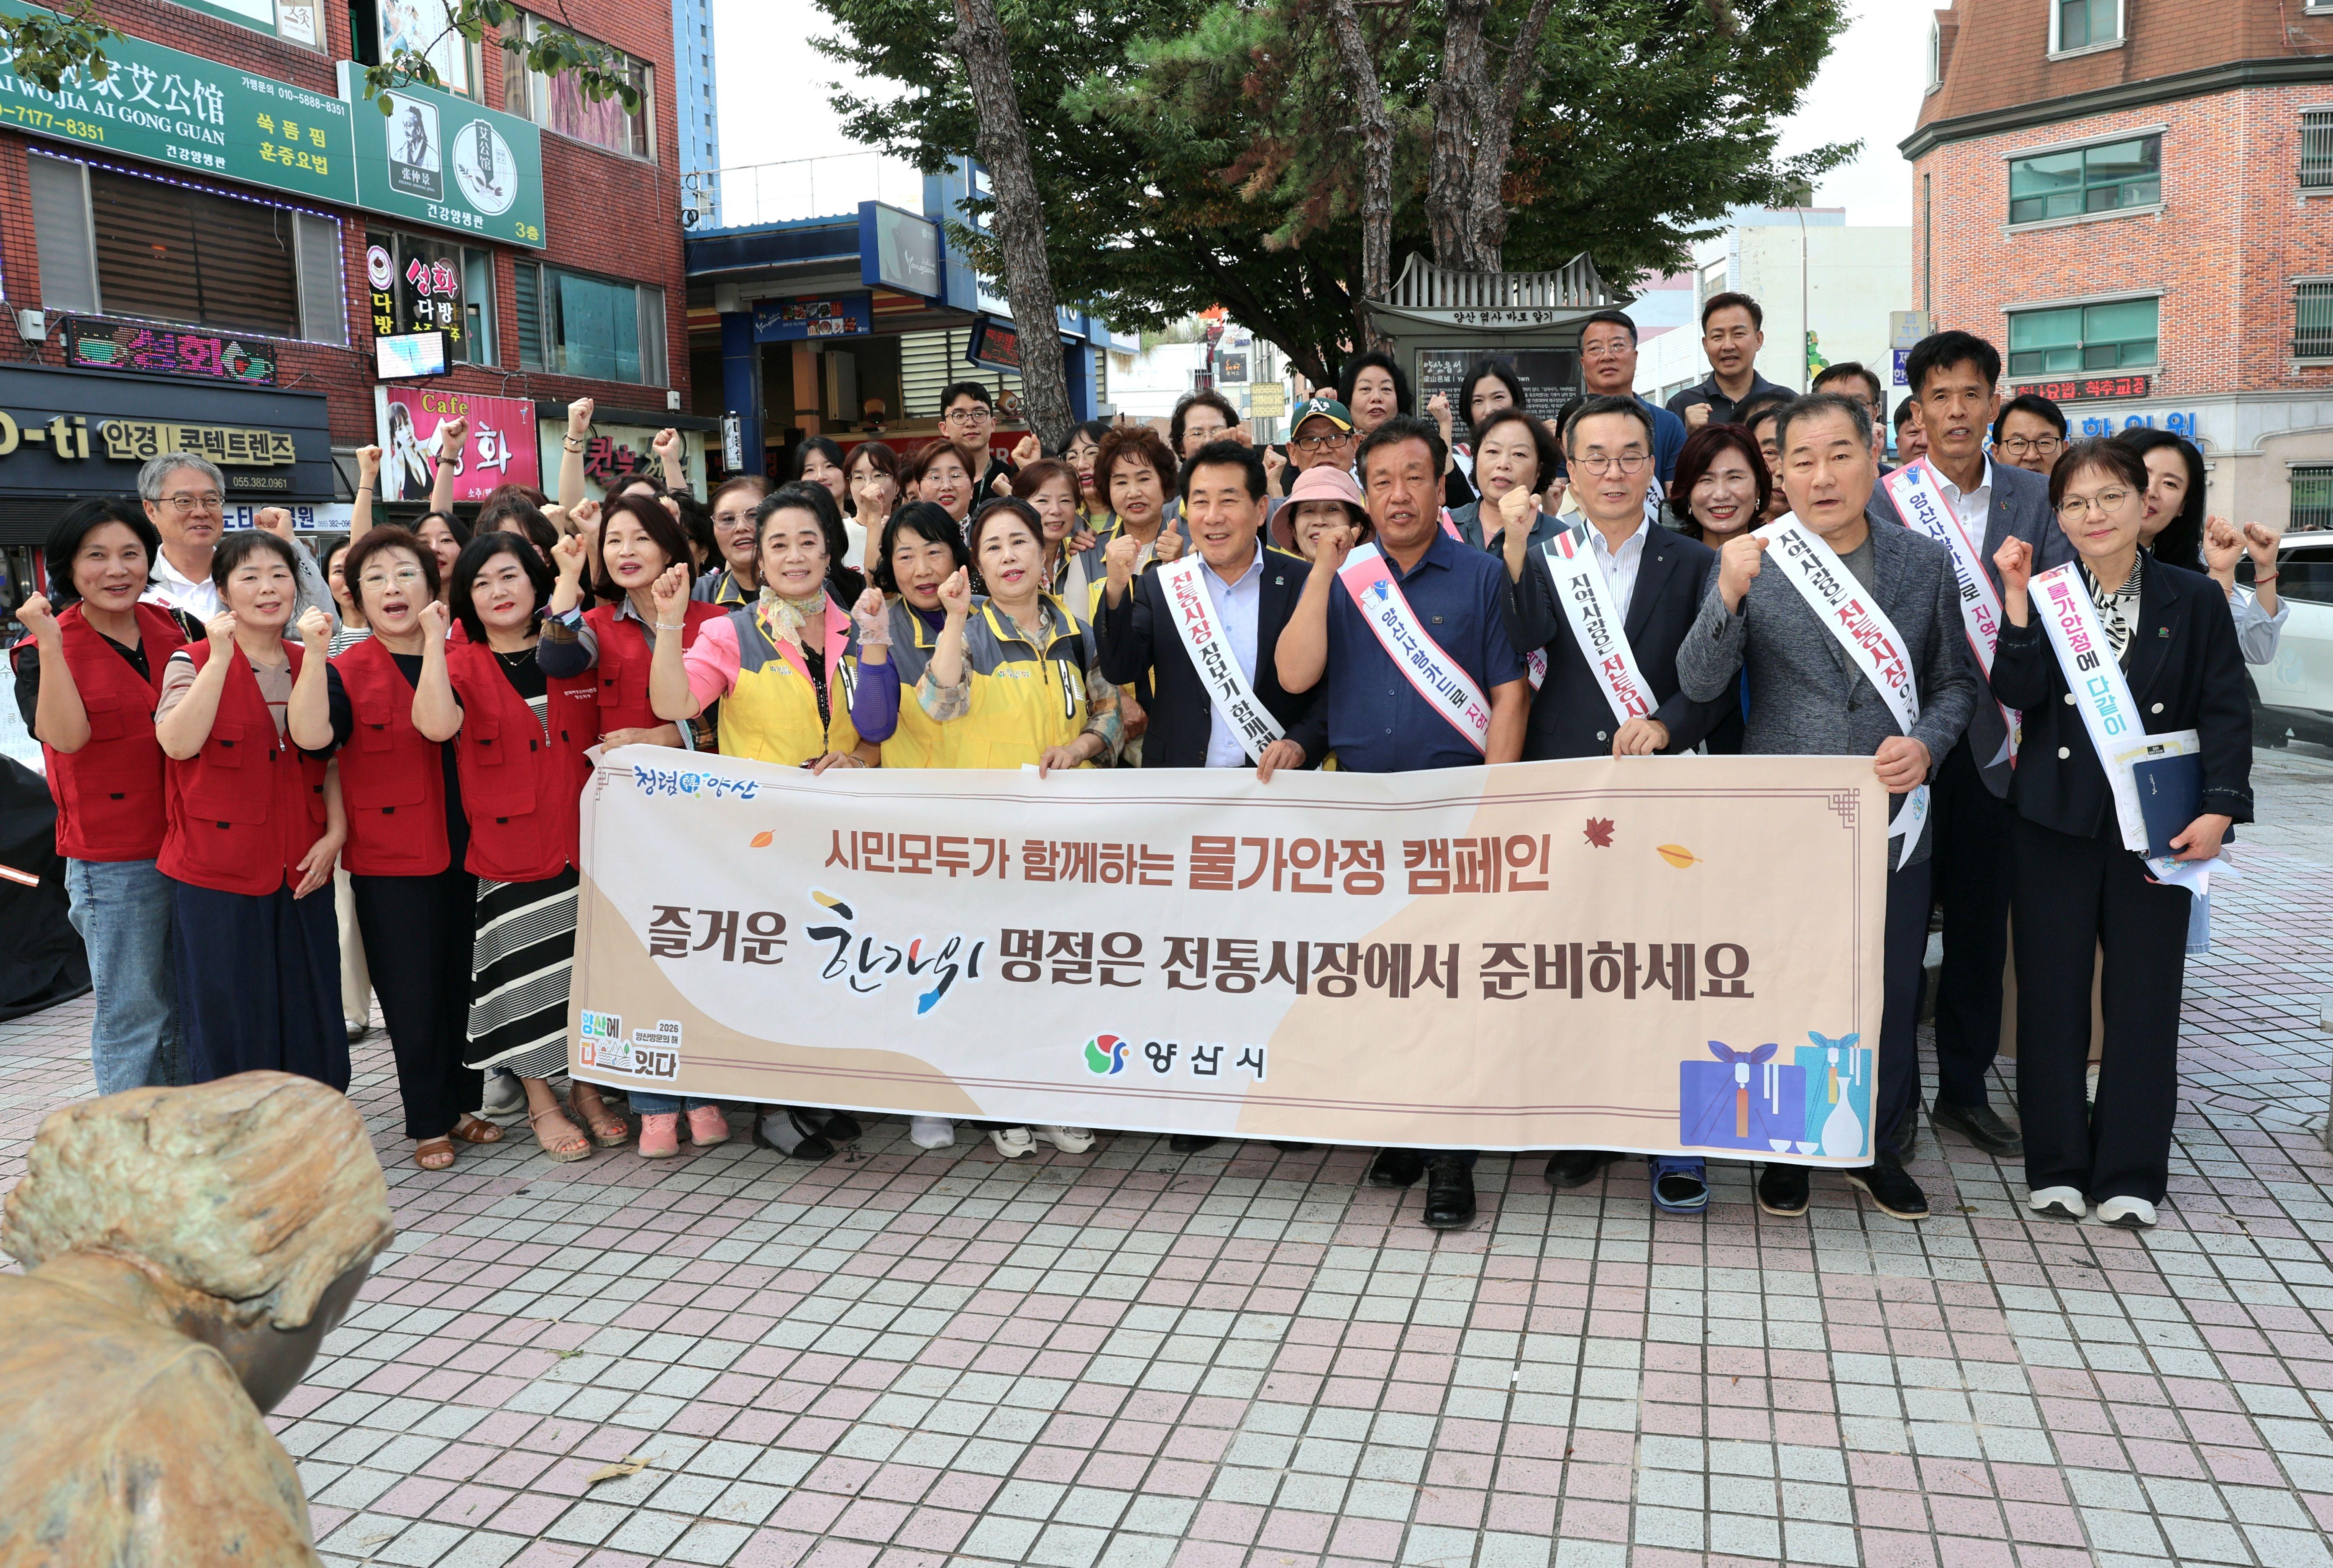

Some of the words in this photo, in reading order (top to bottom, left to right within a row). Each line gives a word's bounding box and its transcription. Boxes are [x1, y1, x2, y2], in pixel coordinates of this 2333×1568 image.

[242, 77, 274, 95] 가맹문의
[279, 87, 345, 116] 010-5888-8351
[0, 103, 104, 141] -7177-8351
[54, 90, 90, 113] JIA
[93, 100, 115, 119] AI
[119, 107, 171, 133] GONG
[176, 122, 225, 146] GUAN
[166, 143, 226, 170] 건강양생관
[259, 142, 328, 175] 훈증요법
[479, 126, 491, 171] 艾公馆
[402, 167, 430, 186] 张仲景
[427, 203, 484, 230] 건강양생관
[515, 222, 539, 241] 3층
[406, 258, 458, 298] 성화
[904, 250, 936, 275] Yangsan
[372, 293, 394, 335] 다방
[417, 298, 454, 324] 다방
[1454, 311, 1475, 323] 양산
[1480, 312, 1502, 324] 역사
[1506, 313, 1528, 323] 바로
[1532, 310, 1553, 323] 알기
[1423, 360, 1462, 374] 양산읍성
[422, 394, 469, 415] Cafe
[1306, 398, 1330, 416] A's
[106, 424, 159, 456] 안경
[233, 476, 287, 489] 055.382.0961
[1775, 528, 1848, 607] 지역사랑은
[1169, 570, 1212, 645] 전통시장
[1199, 641, 1241, 702] 장보기
[1568, 573, 1614, 656] 지역사랑은
[1599, 653, 1651, 720] 전통시
[1381, 607, 1468, 709] 양산사랑카드로
[2046, 581, 2100, 672] 물가안정에
[2086, 675, 2127, 736] 다같이
[707, 777, 759, 799] 양산
[824, 829, 1010, 879] 시민모두가
[1022, 839, 1174, 886] 함께하는
[1189, 835, 1385, 896] 물가안정
[1403, 833, 1551, 896] 캠페인
[648, 904, 788, 965] 즐거운
[807, 890, 985, 1015] 한가위
[1000, 928, 1145, 987] 명절은
[1160, 936, 1460, 999] 전통시장에서
[1480, 941, 1755, 1002] 준비하세요
[583, 1012, 619, 1039] 양산에
[635, 1032, 669, 1044] 양산방문의
[671, 1035, 678, 1045] 해
[659, 1023, 679, 1033] 2026
[1144, 1040, 1265, 1079] 양산시
